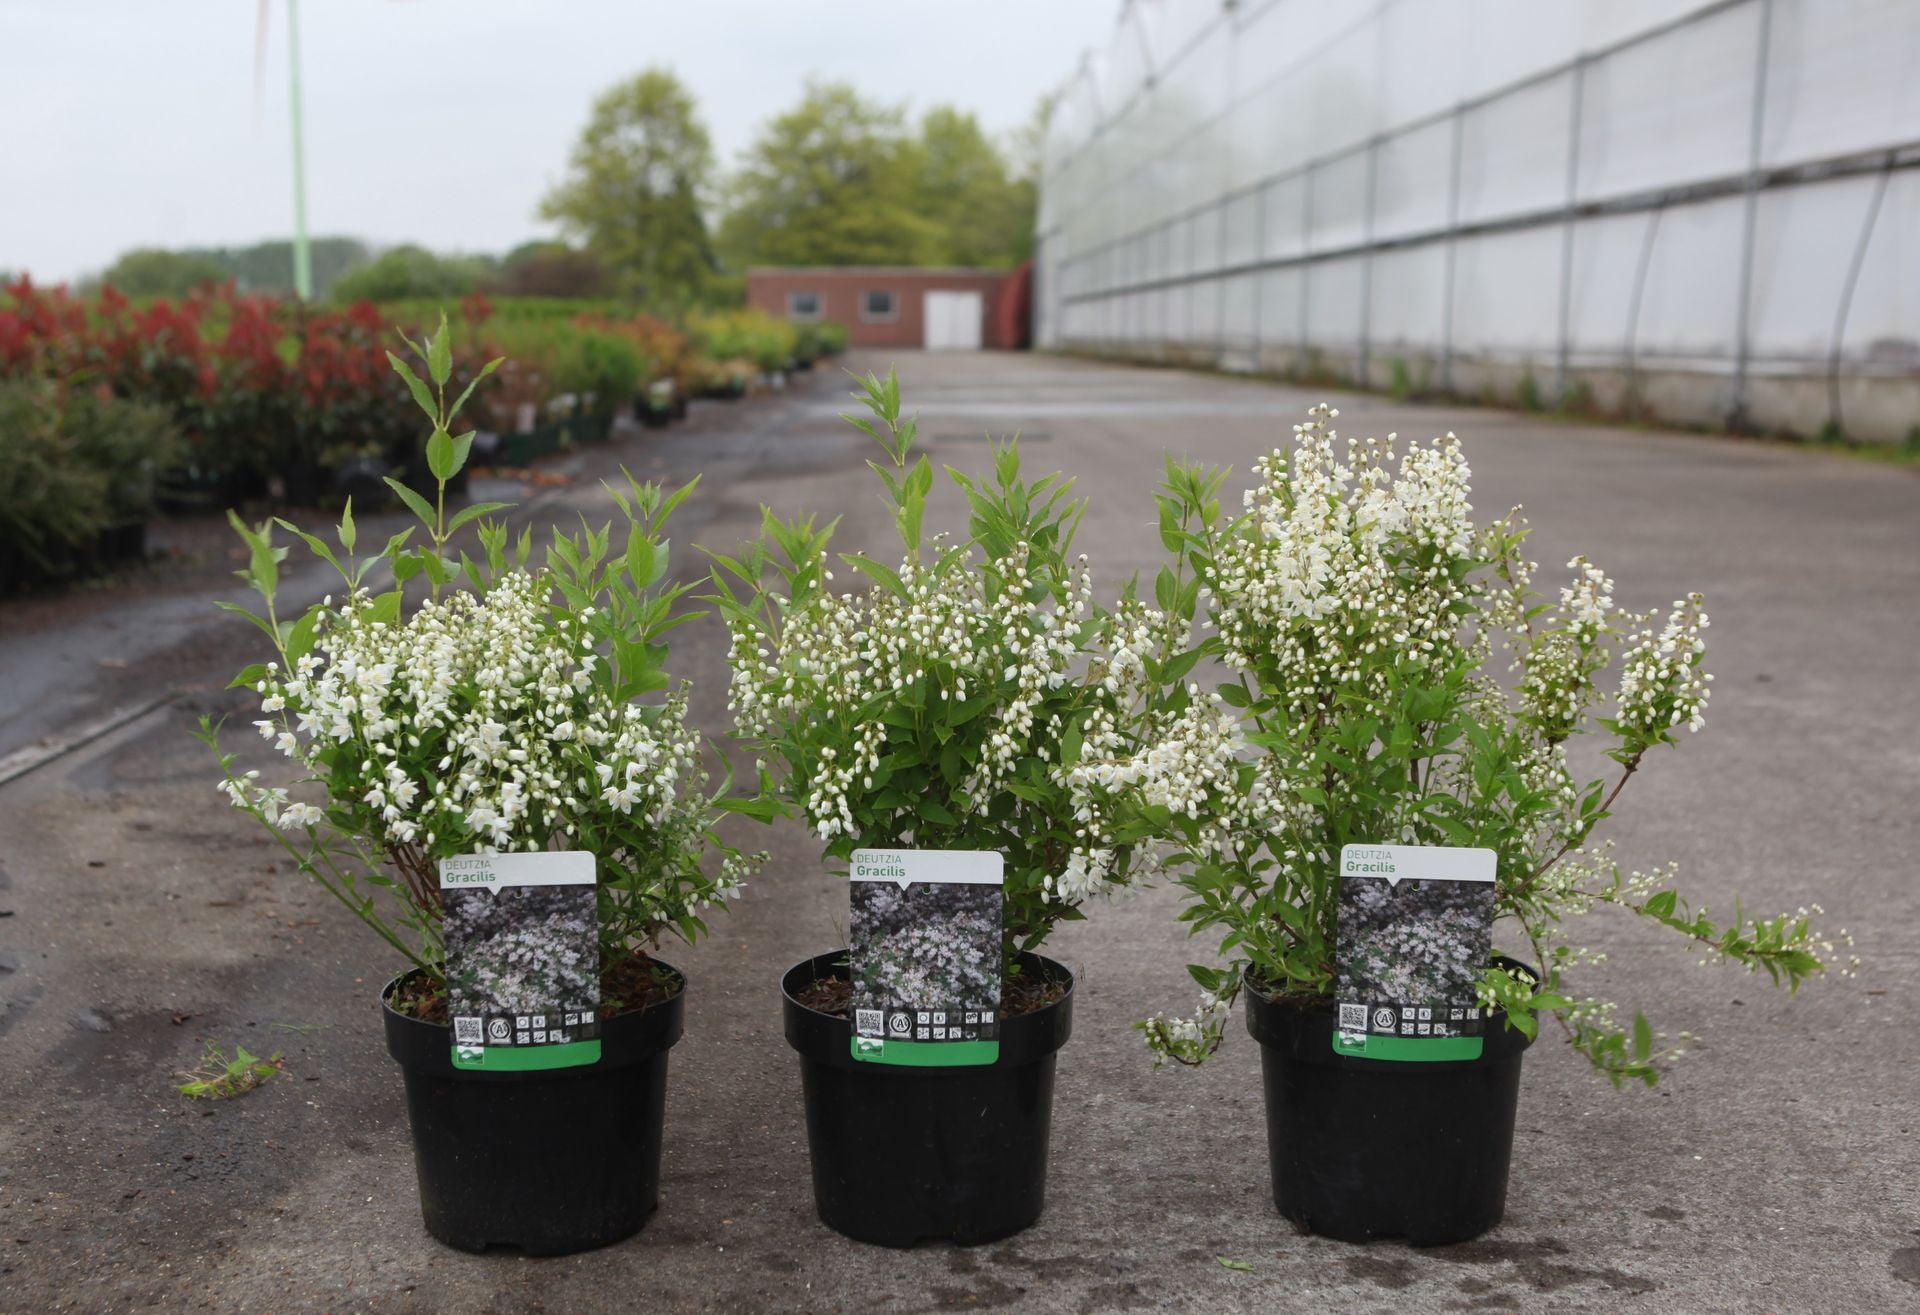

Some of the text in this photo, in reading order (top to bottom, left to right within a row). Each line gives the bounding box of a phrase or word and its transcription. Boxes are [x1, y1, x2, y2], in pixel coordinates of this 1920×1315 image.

[857, 854, 902, 864] DEUTZIA
[1347, 850, 1392, 860] DEUTZIA
[445, 860, 491, 870] DEUTZIA
[1346, 861, 1396, 873] Gracilis
[857, 865, 906, 877] Gracilis
[446, 872, 496, 883] Gracilis
